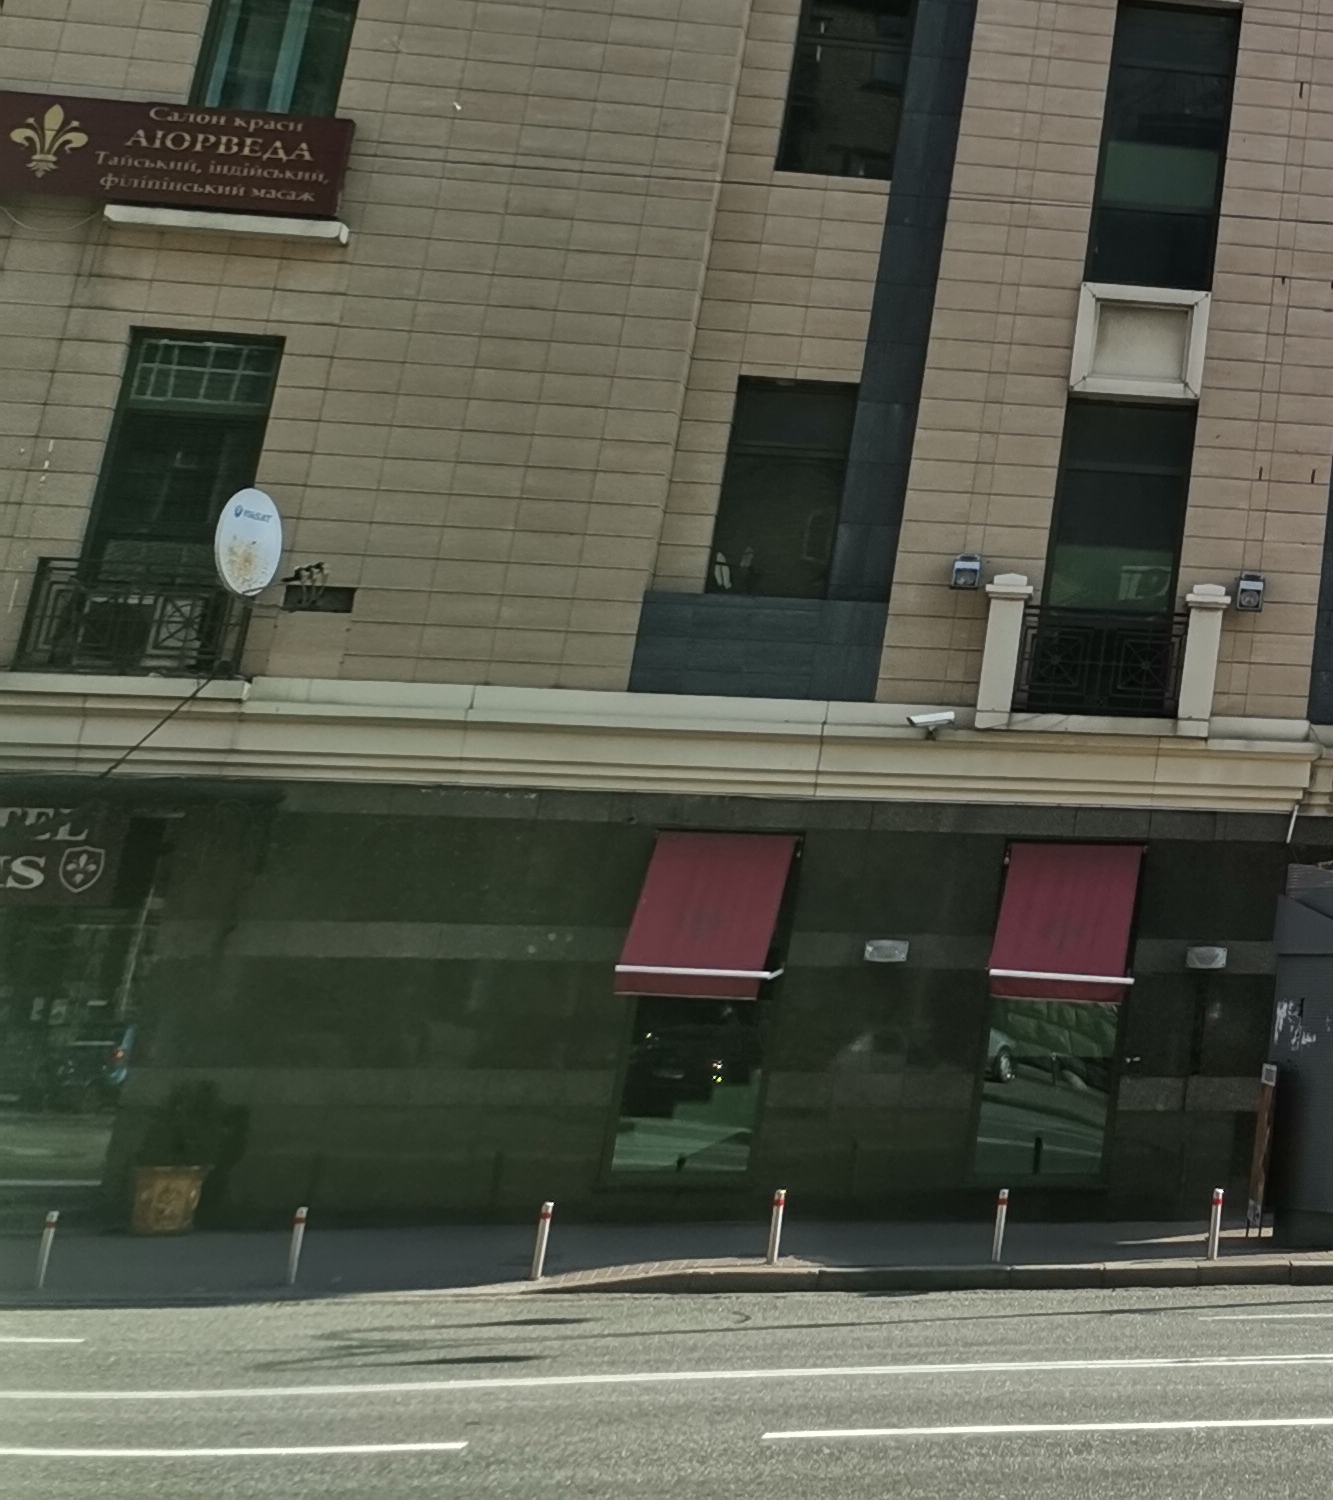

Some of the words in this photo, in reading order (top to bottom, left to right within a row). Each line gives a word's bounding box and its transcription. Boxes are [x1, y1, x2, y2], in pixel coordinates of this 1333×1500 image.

[149, 106, 226, 127] Салон
[233, 116, 304, 133] краси
[124, 128, 315, 163] АЮРВЕДА
[94, 150, 203, 174] Тайський,
[208, 160, 330, 185] індійський,
[250, 187, 316, 203] масаж
